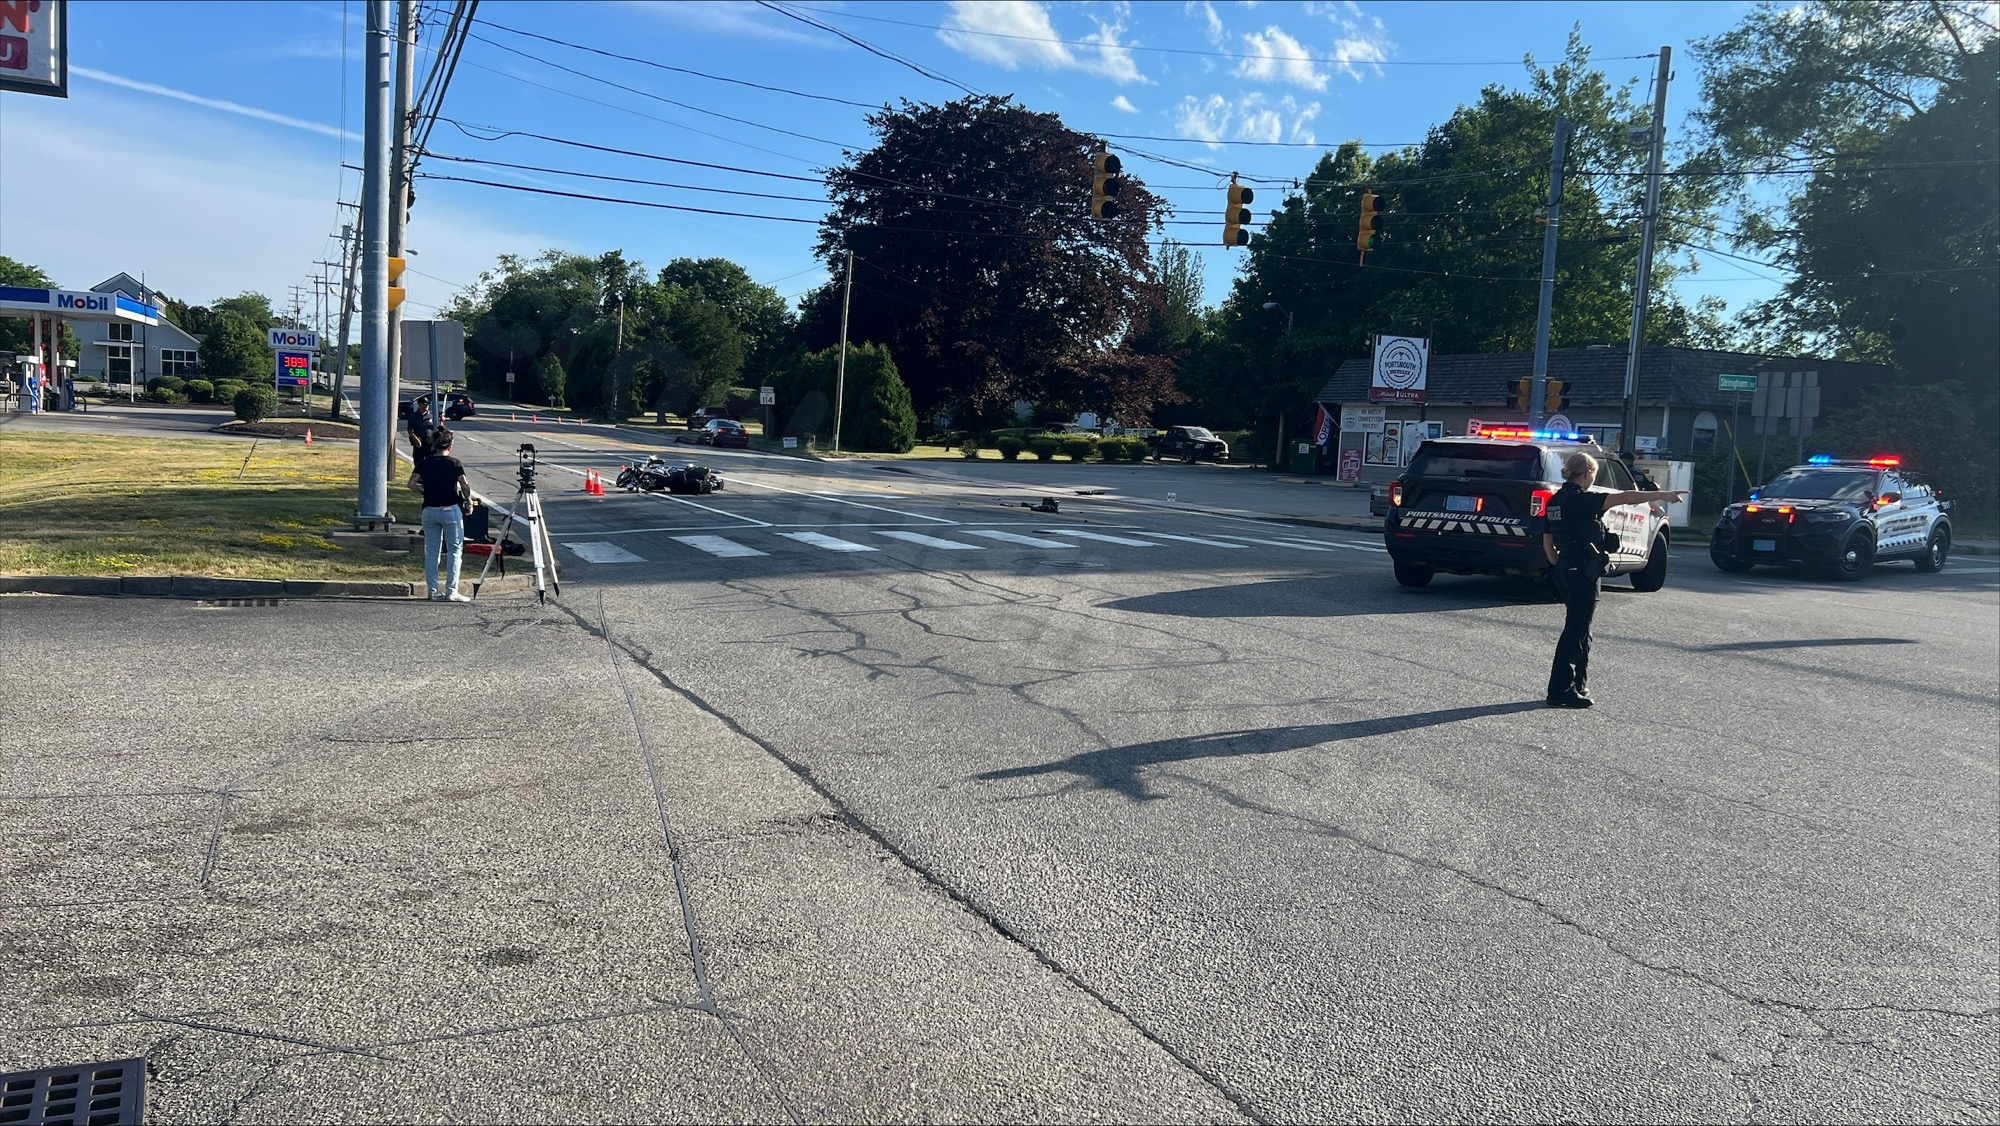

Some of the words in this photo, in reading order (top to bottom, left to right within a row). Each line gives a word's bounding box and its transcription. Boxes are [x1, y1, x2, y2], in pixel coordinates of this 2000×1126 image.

[57, 294, 108, 311] Mobil
[273, 332, 315, 346] Mobil
[1385, 361, 1416, 370] PORTSMOUTH
[1721, 378, 1748, 390] Stringham
[1400, 391, 1419, 399] ULTRA
[1406, 511, 1478, 521] PORTSMOUTH
[1480, 515, 1521, 525] POLICE
[1607, 510, 1644, 534] POLICE
